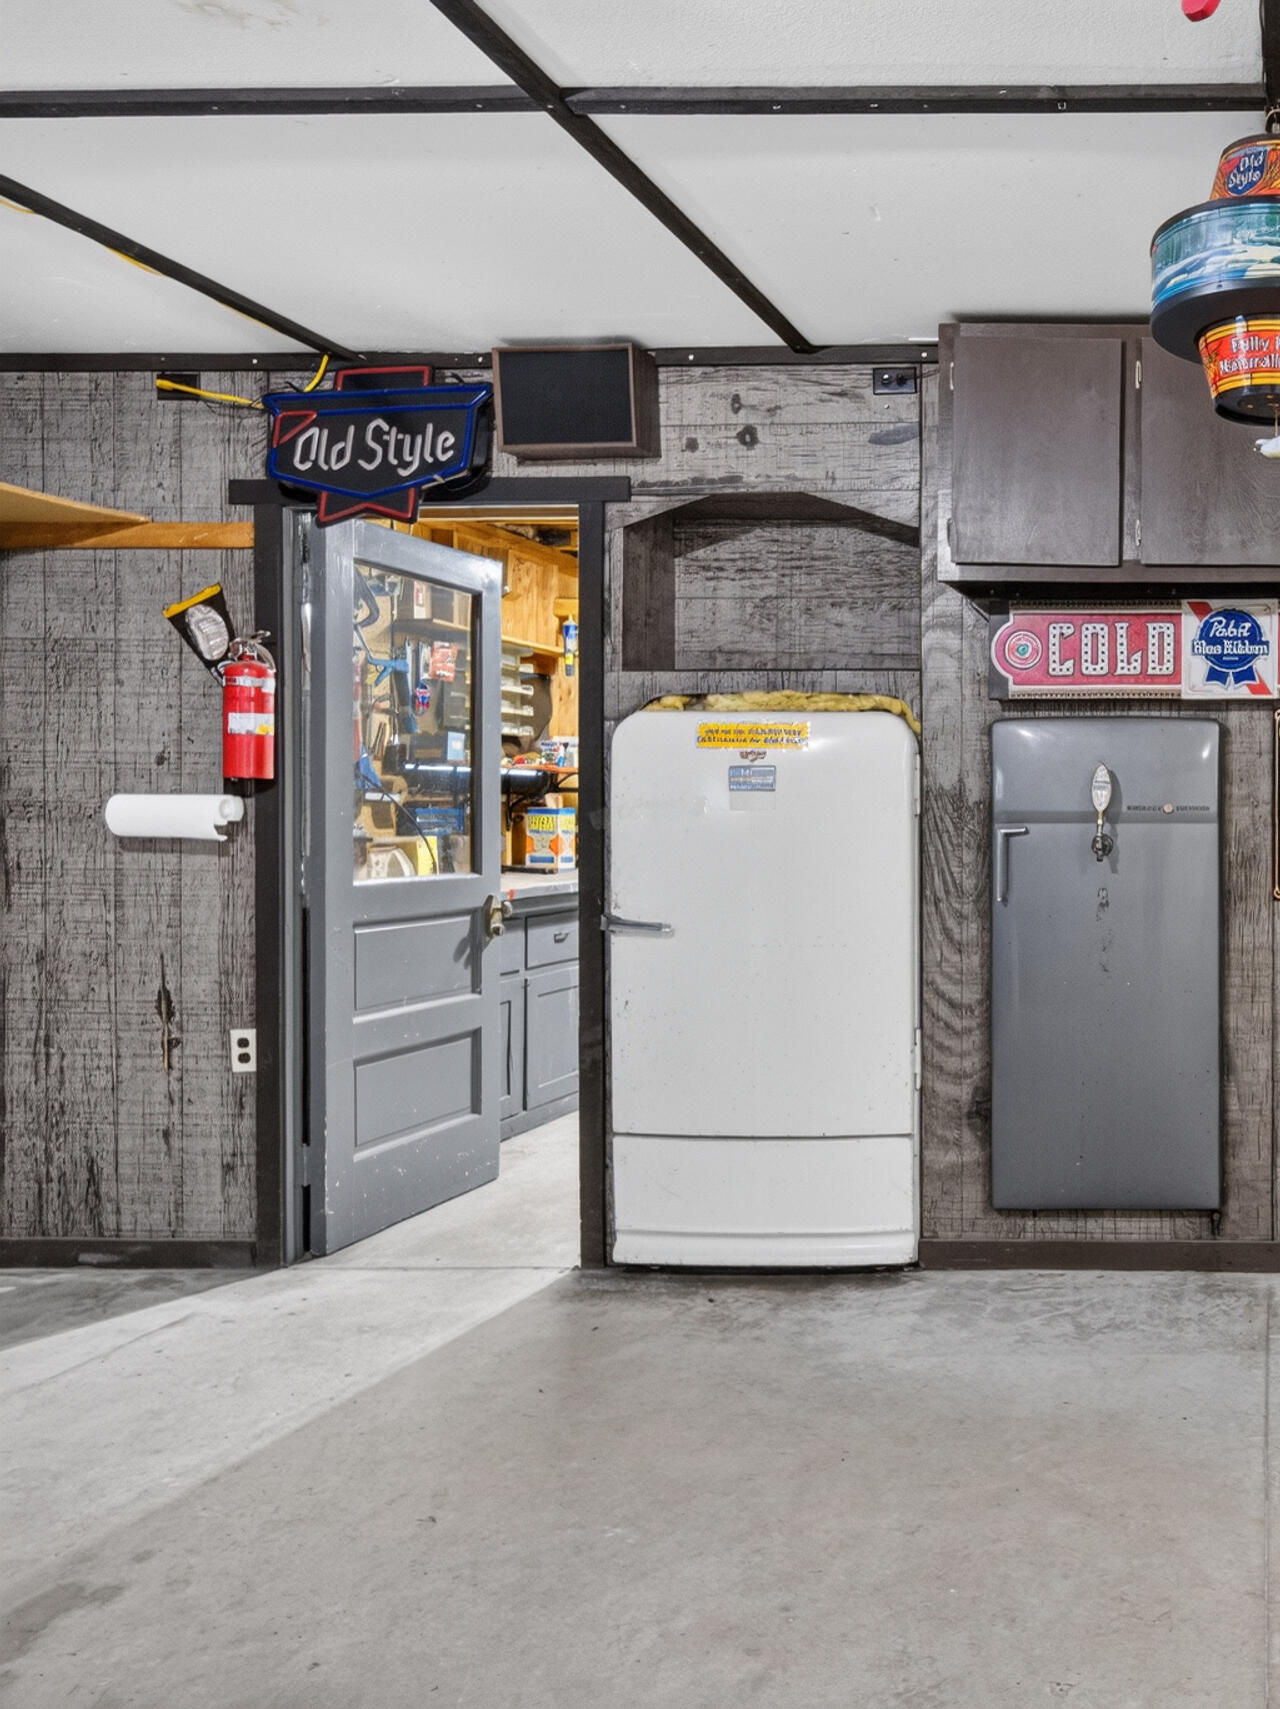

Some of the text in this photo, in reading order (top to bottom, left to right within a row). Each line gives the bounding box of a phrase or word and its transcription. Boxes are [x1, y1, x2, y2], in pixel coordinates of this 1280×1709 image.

[1240, 151, 1264, 171] Old
[1228, 170, 1261, 190] Style
[1231, 335, 1269, 353] Fully
[293, 418, 455, 477] Old Style
[1209, 616, 1252, 637] Pabst
[1048, 621, 1175, 676] COLD
[1193, 639, 1268, 655] Blue Ribbon
